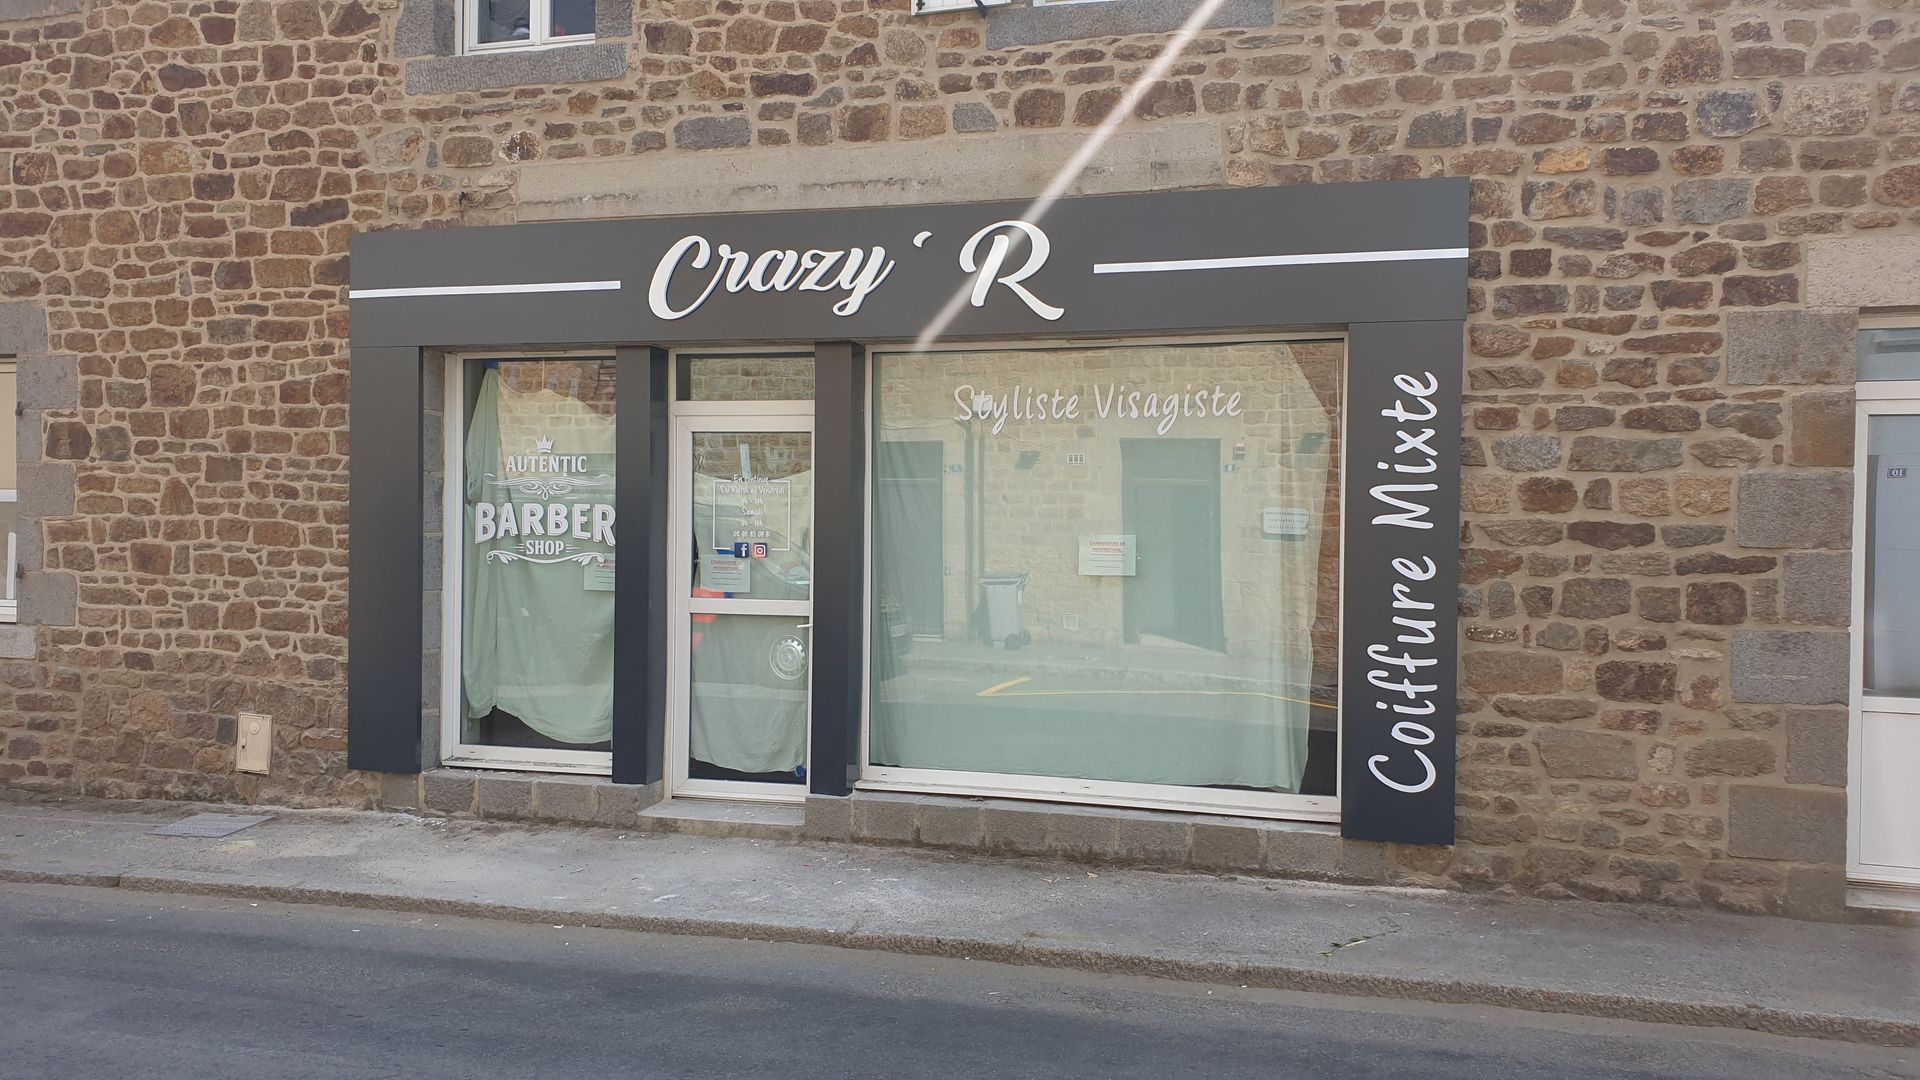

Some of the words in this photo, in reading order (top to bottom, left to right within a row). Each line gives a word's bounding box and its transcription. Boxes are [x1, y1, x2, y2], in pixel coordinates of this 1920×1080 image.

[958, 220, 1065, 321] R
[953, 384, 1080, 436] Styliste
[1094, 383, 1242, 436] Visagiste
[506, 455, 587, 473] AUTENTIC
[1369, 371, 1438, 530] Mixte
[474, 502, 616, 547] BARBER
[525, 540, 565, 556] SHOP
[1367, 555, 1438, 794] Coiffure
